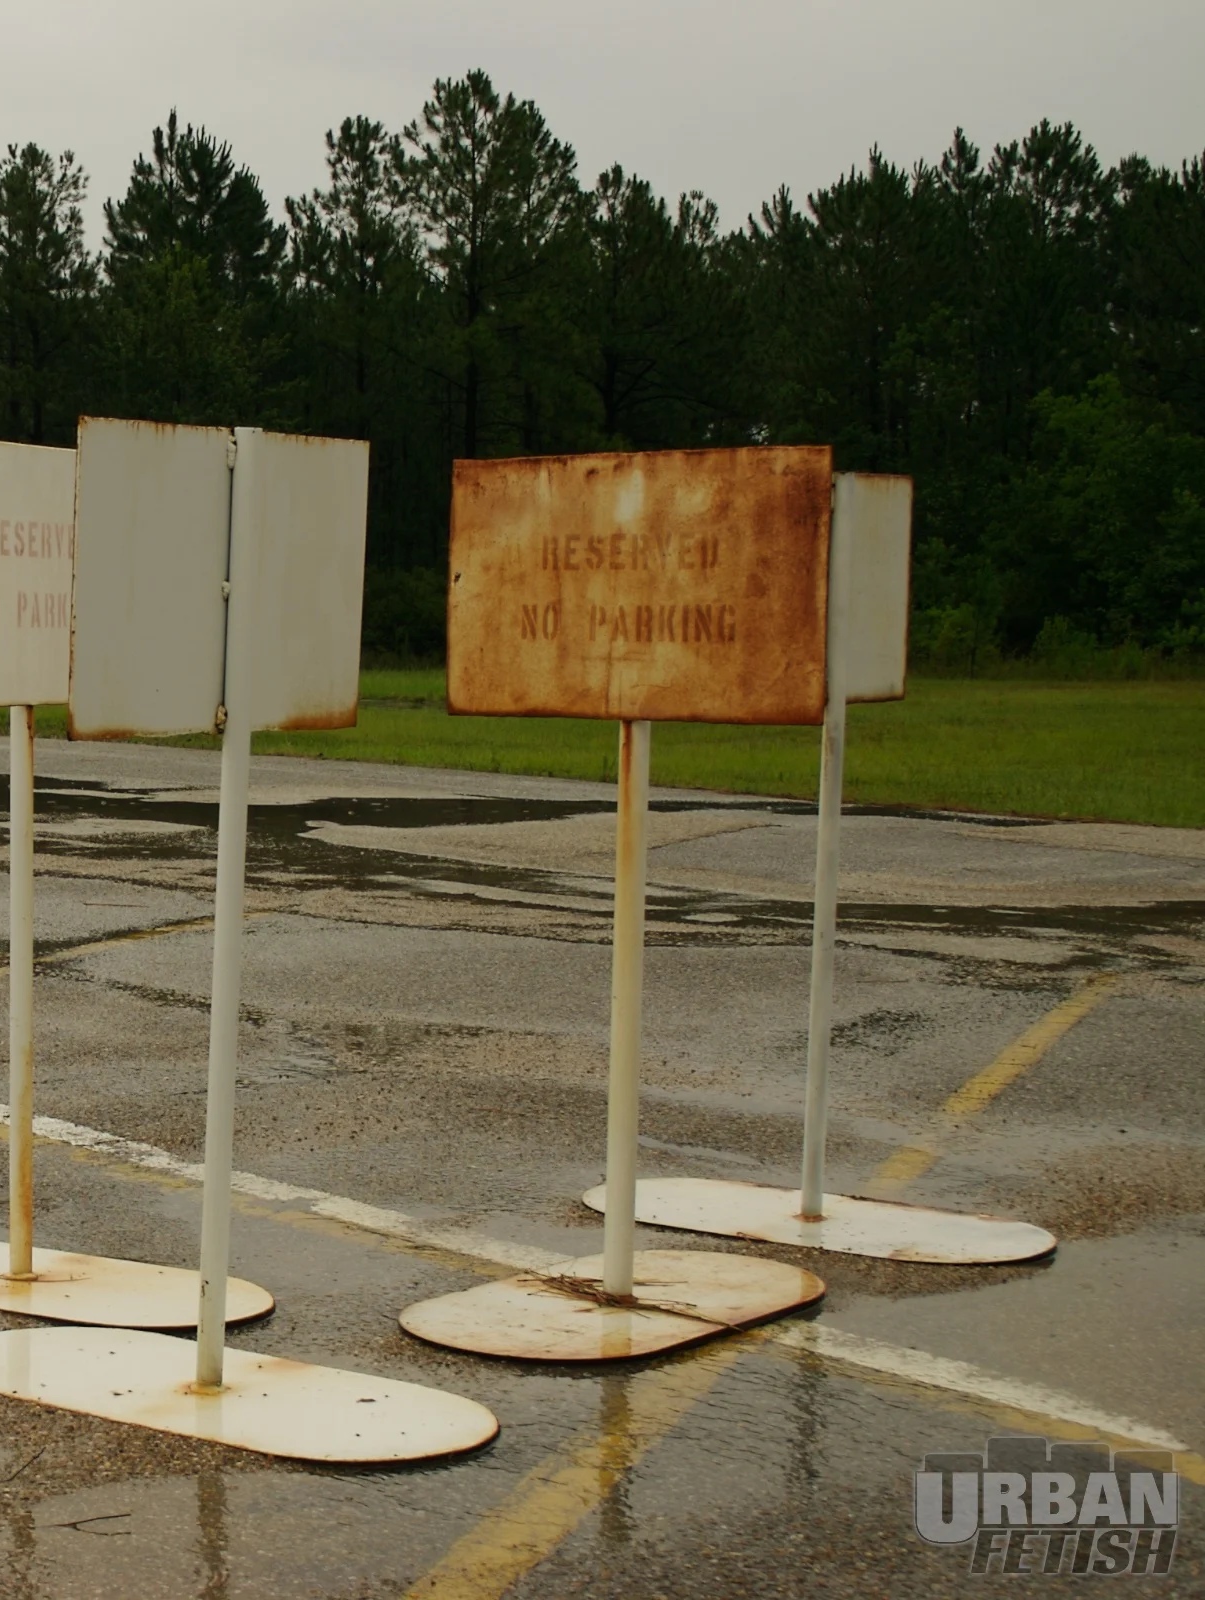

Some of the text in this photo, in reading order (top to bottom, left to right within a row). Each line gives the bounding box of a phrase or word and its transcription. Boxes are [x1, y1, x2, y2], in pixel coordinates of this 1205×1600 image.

[541, 532, 720, 571] RESERVED
[16, 590, 68, 628] PARK
[520, 604, 737, 643] NO PARKING
